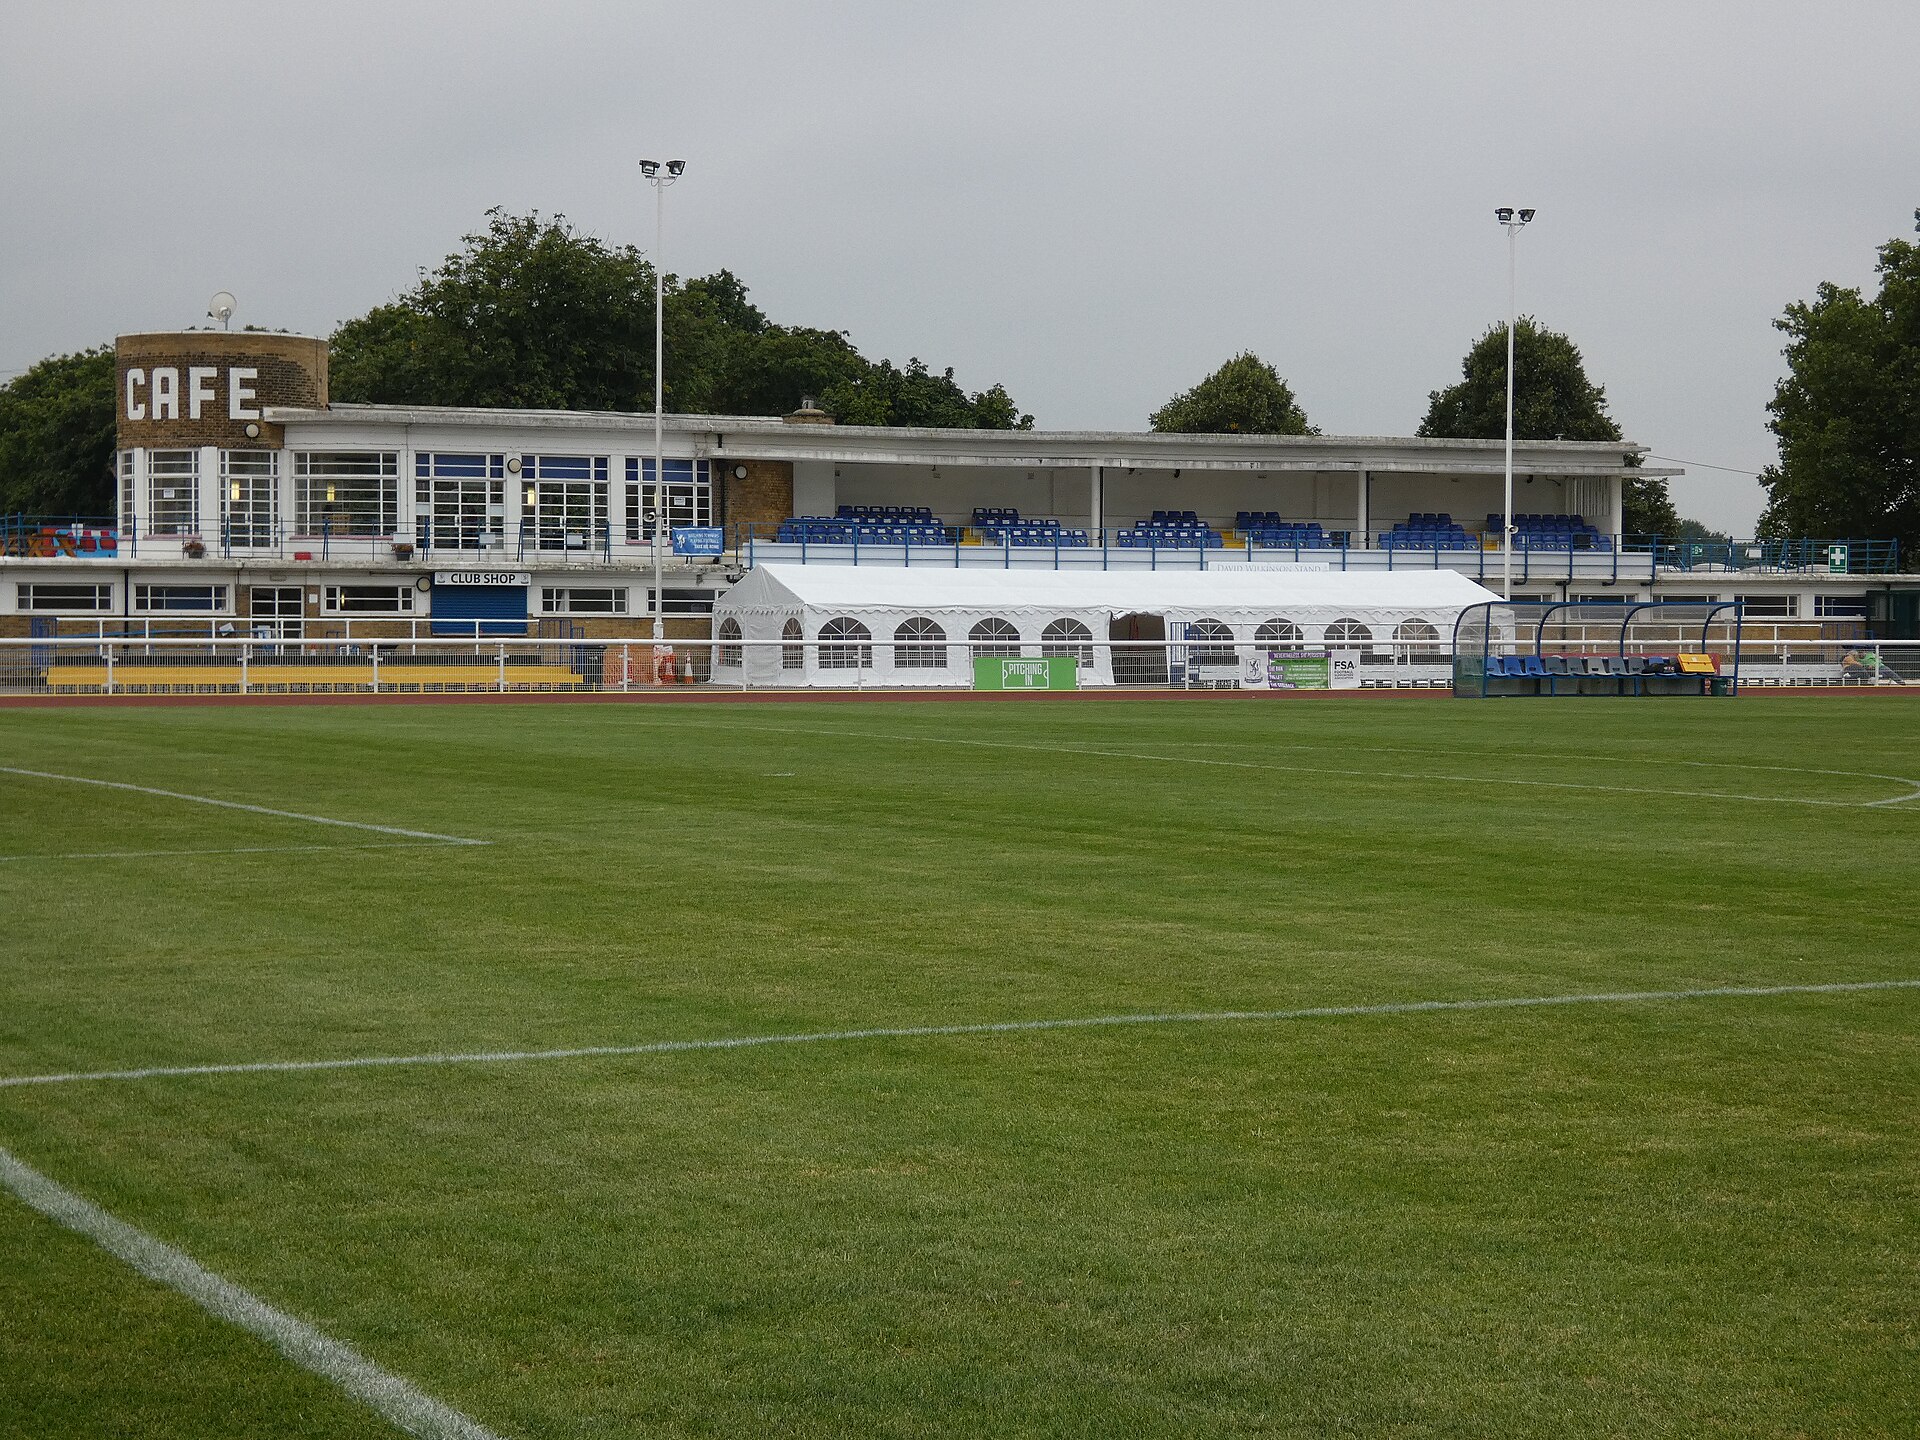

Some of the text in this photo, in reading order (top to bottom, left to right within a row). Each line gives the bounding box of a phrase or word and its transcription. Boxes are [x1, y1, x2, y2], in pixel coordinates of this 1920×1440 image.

[127, 367, 259, 420] CAFE
[1217, 563, 1321, 572] DAVID WILKINSON STAND
[451, 573, 516, 584] CLUB SHOP
[1008, 663, 1042, 675] PITCHING
[1334, 660, 1355, 669] FSA
[1025, 675, 1033, 686] IN
